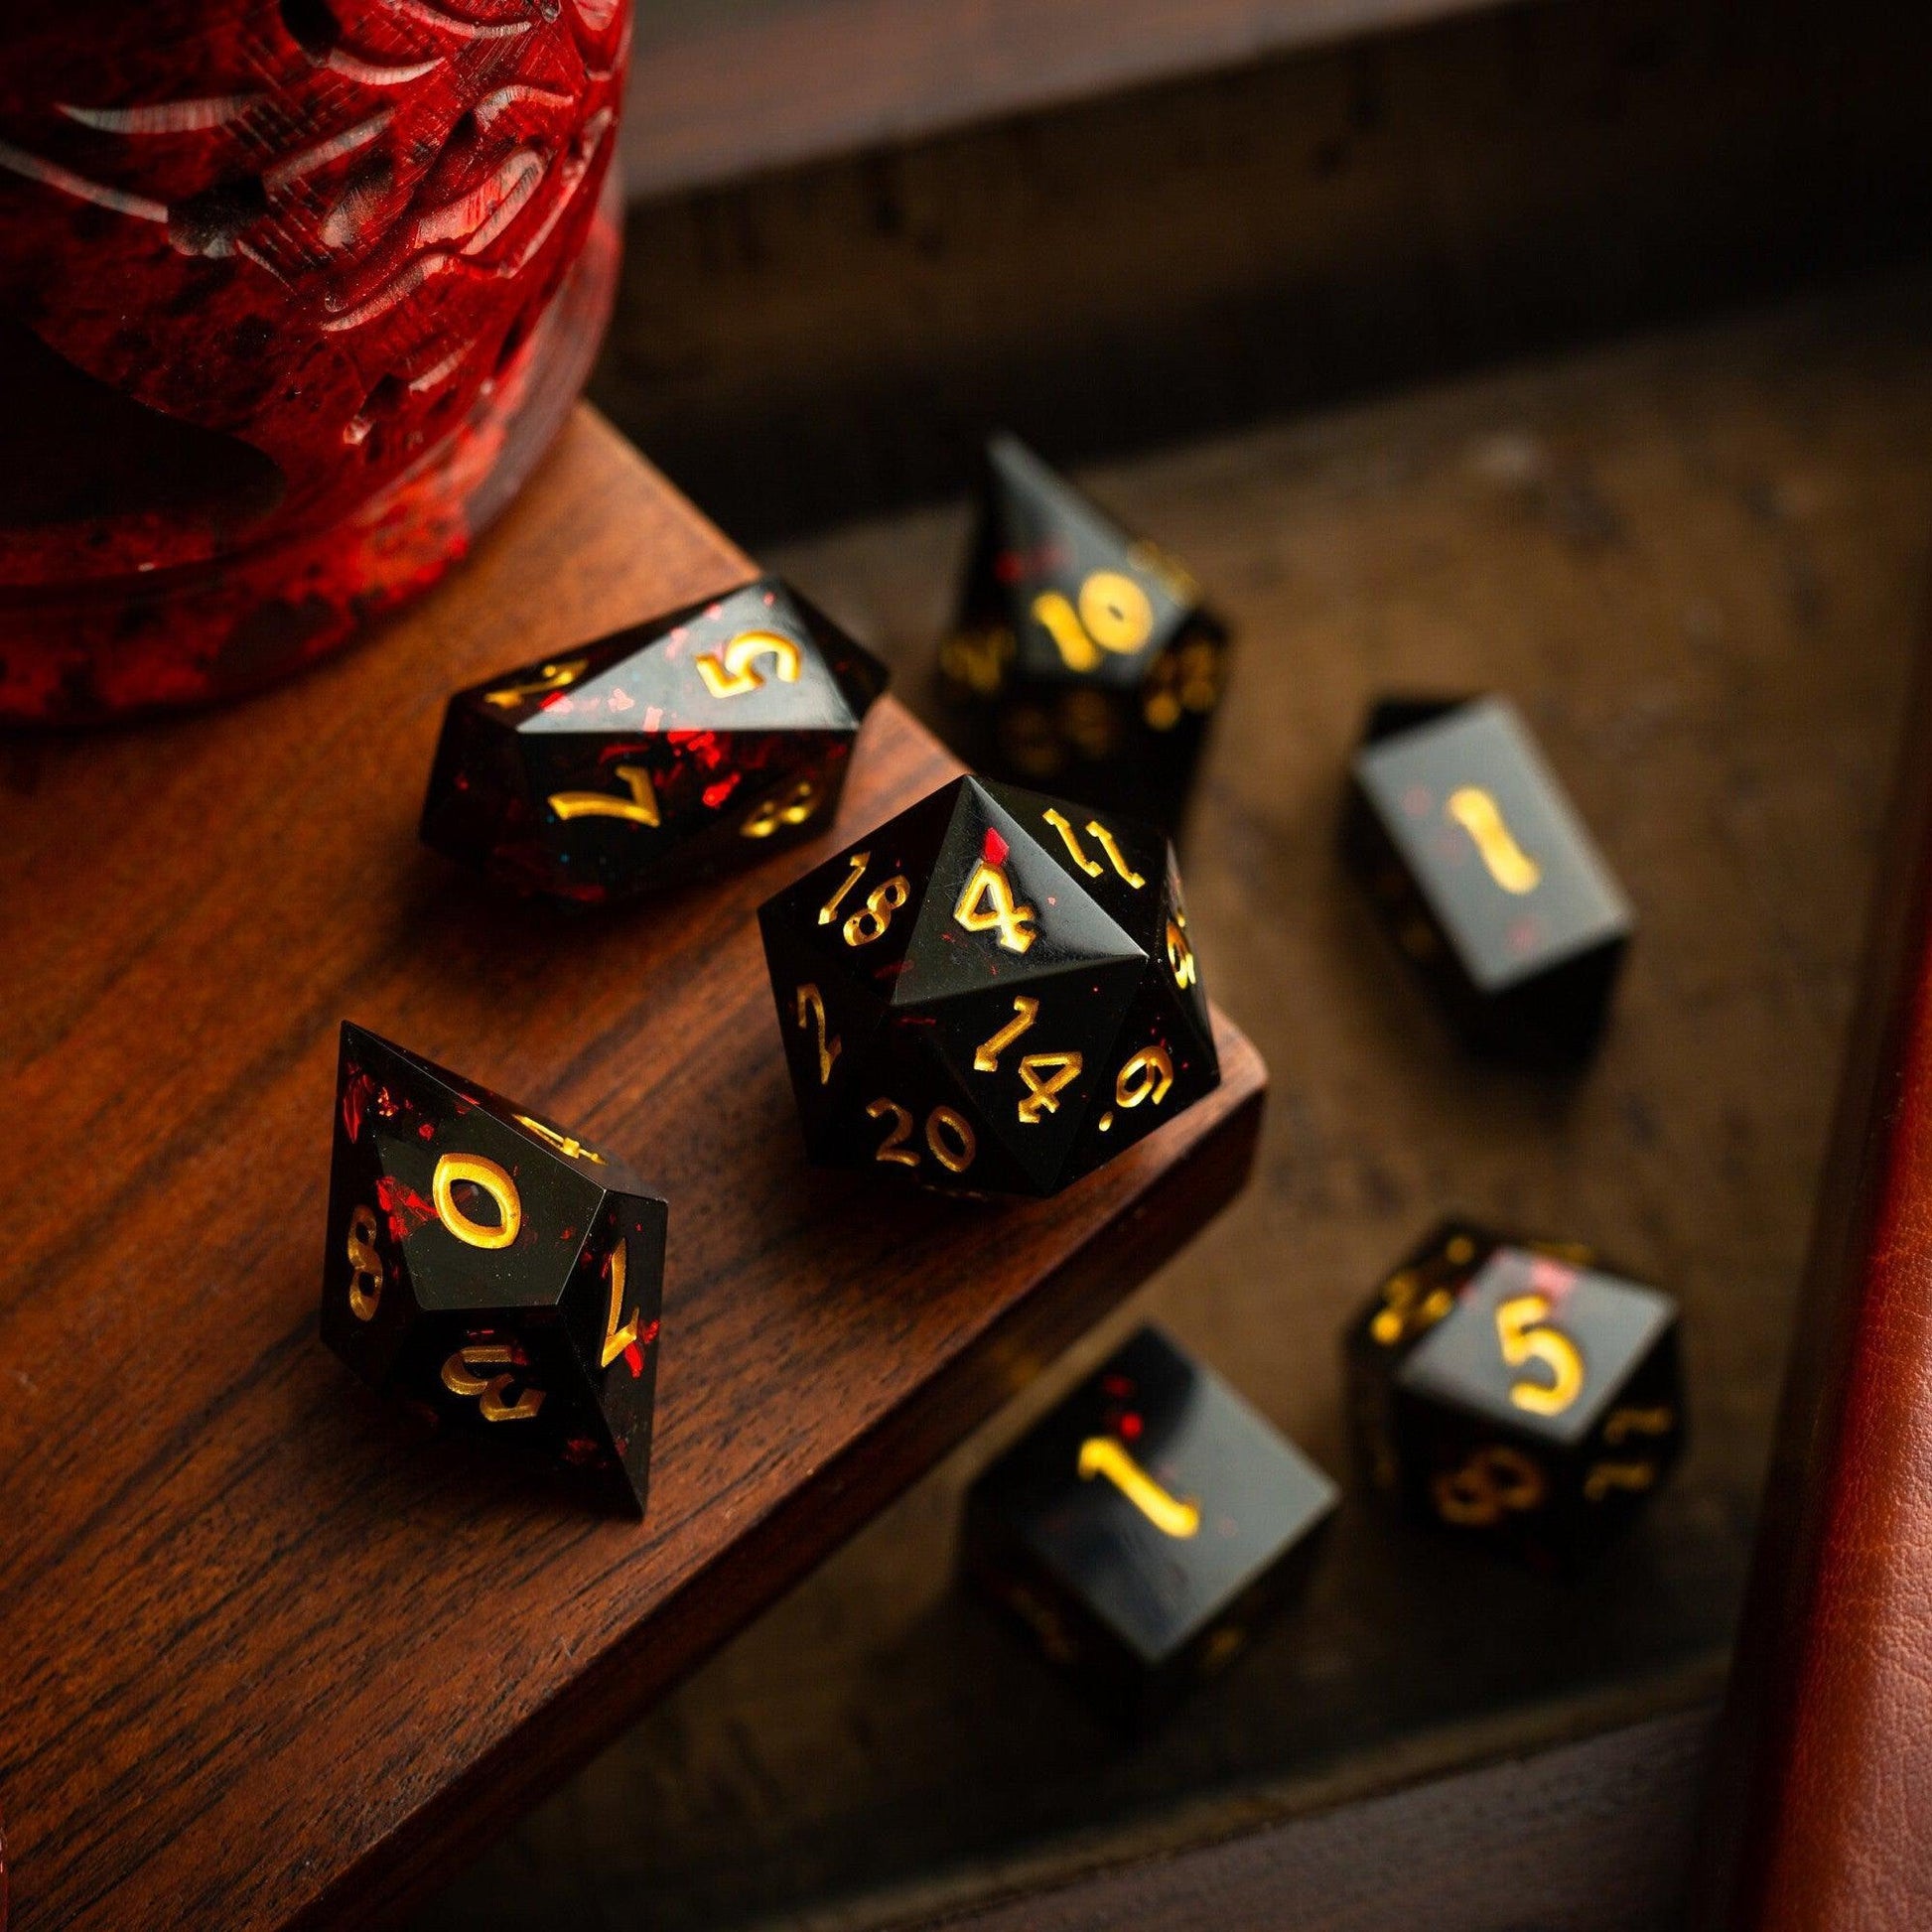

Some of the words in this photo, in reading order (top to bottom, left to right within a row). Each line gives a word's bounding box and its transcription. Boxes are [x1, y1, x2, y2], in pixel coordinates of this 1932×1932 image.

[695, 629, 801, 699] 5
[1033, 570, 1154, 673] 10
[547, 765, 661, 827] 7
[1042, 808, 1146, 890] 11
[817, 851, 910, 947] 18
[954, 858, 1036, 953] 4
[973, 995, 1083, 1124] 14
[866, 1095, 977, 1173] 20
[432, 1153, 522, 1250] 0
[346, 1204, 383, 1321] 8
[1494, 1294, 1585, 1417] 5
